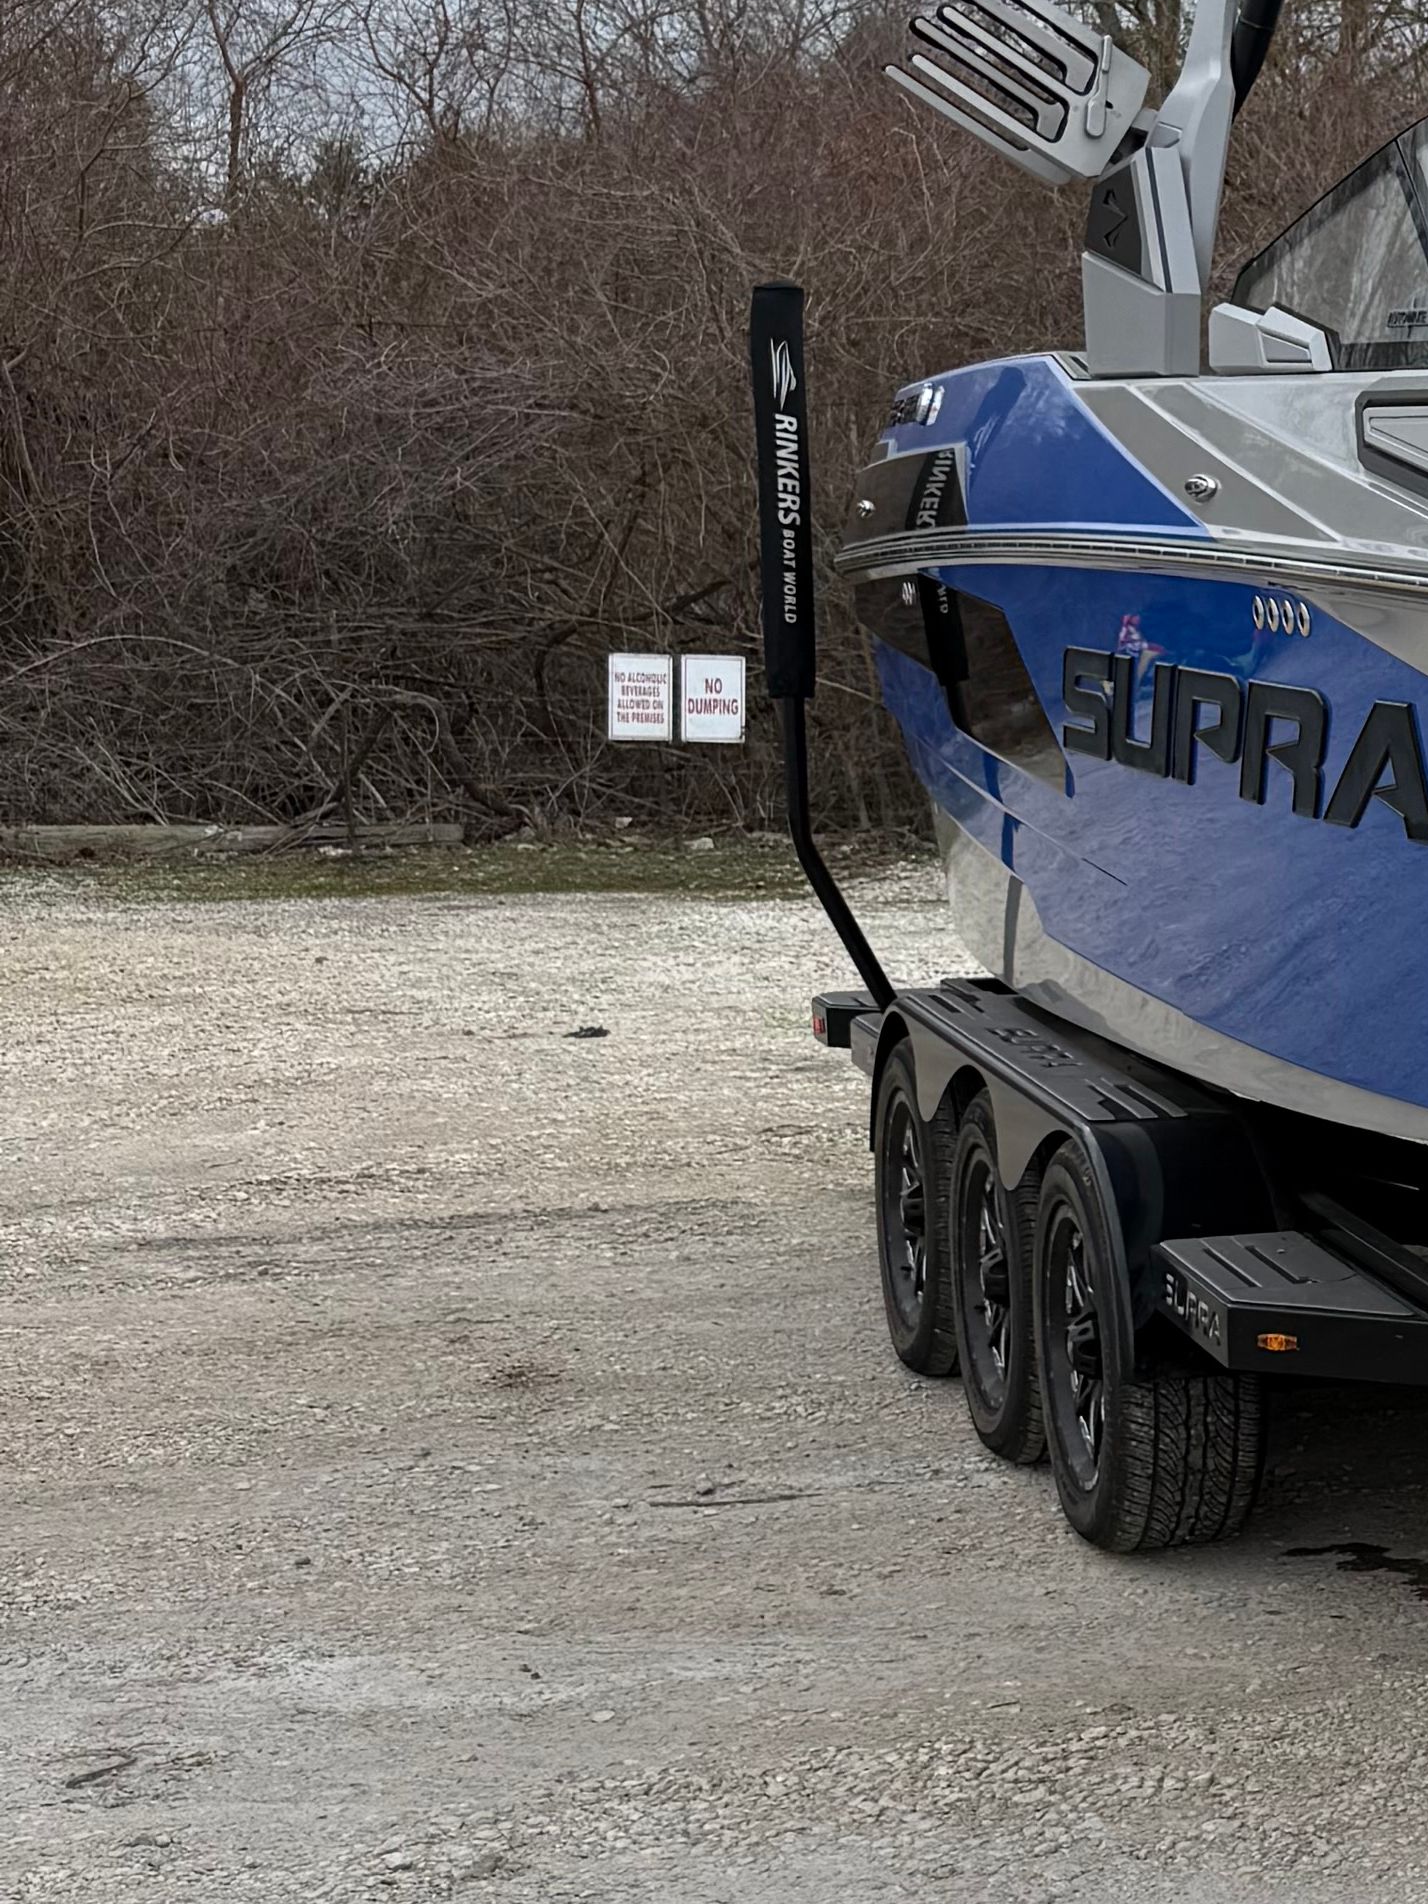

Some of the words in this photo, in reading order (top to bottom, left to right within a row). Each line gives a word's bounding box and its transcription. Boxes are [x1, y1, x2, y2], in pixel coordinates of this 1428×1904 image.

[775, 413, 801, 526] RINKERS
[782, 528, 796, 569] BOAT
[783, 572, 797, 624] WORLD
[614, 672, 626, 683] NO
[627, 672, 667, 684] ALCOHOLIC
[705, 678, 723, 694] NO
[621, 685, 661, 697] BEVERAGES
[617, 699, 650, 710] ALLOWED
[653, 700, 664, 710] ON
[687, 698, 739, 715] DUMPING
[617, 712, 630, 723] THE
[632, 712, 665, 725] PREMISES
[1164, 1272, 1222, 1347] SUPRA
